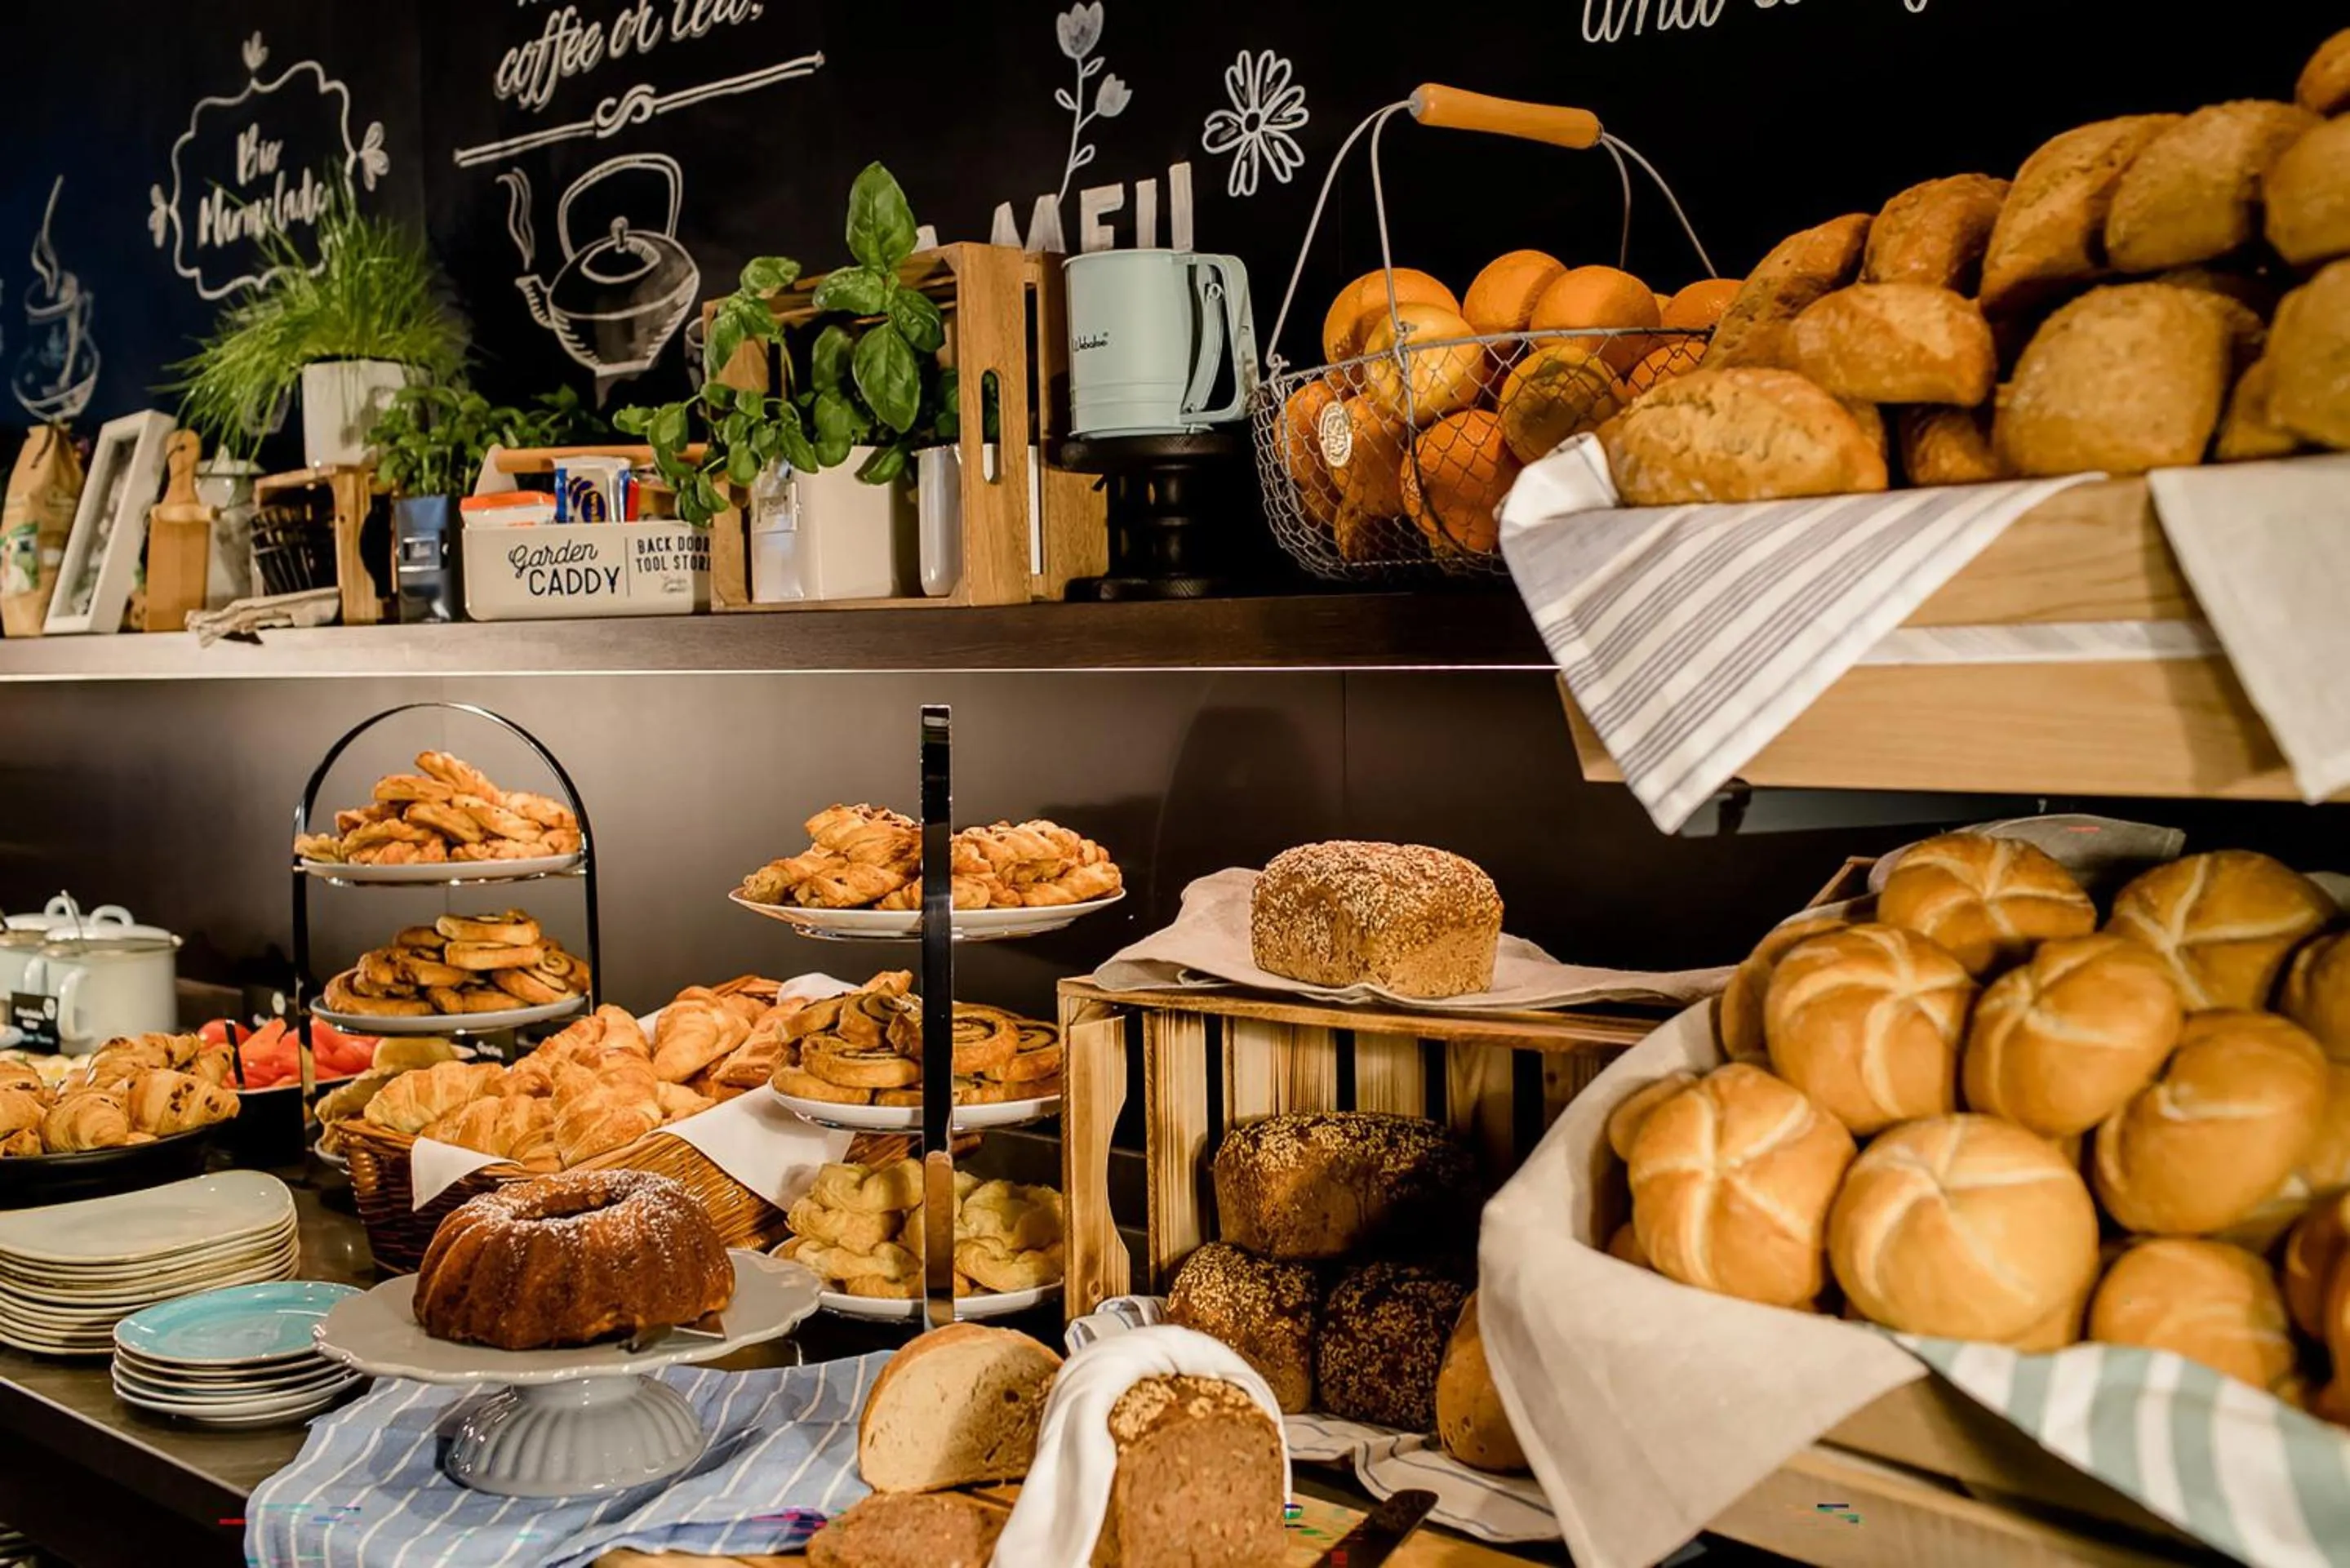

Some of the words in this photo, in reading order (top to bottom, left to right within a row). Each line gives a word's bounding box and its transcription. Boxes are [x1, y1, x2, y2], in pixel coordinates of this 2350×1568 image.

[494, 6, 605, 113] coffee
[508, 539, 598, 579] Garden
[637, 535, 673, 554] BACK
[677, 535, 710, 553] DOOR
[636, 555, 668, 573] TOOL
[528, 566, 620, 597] CADDY
